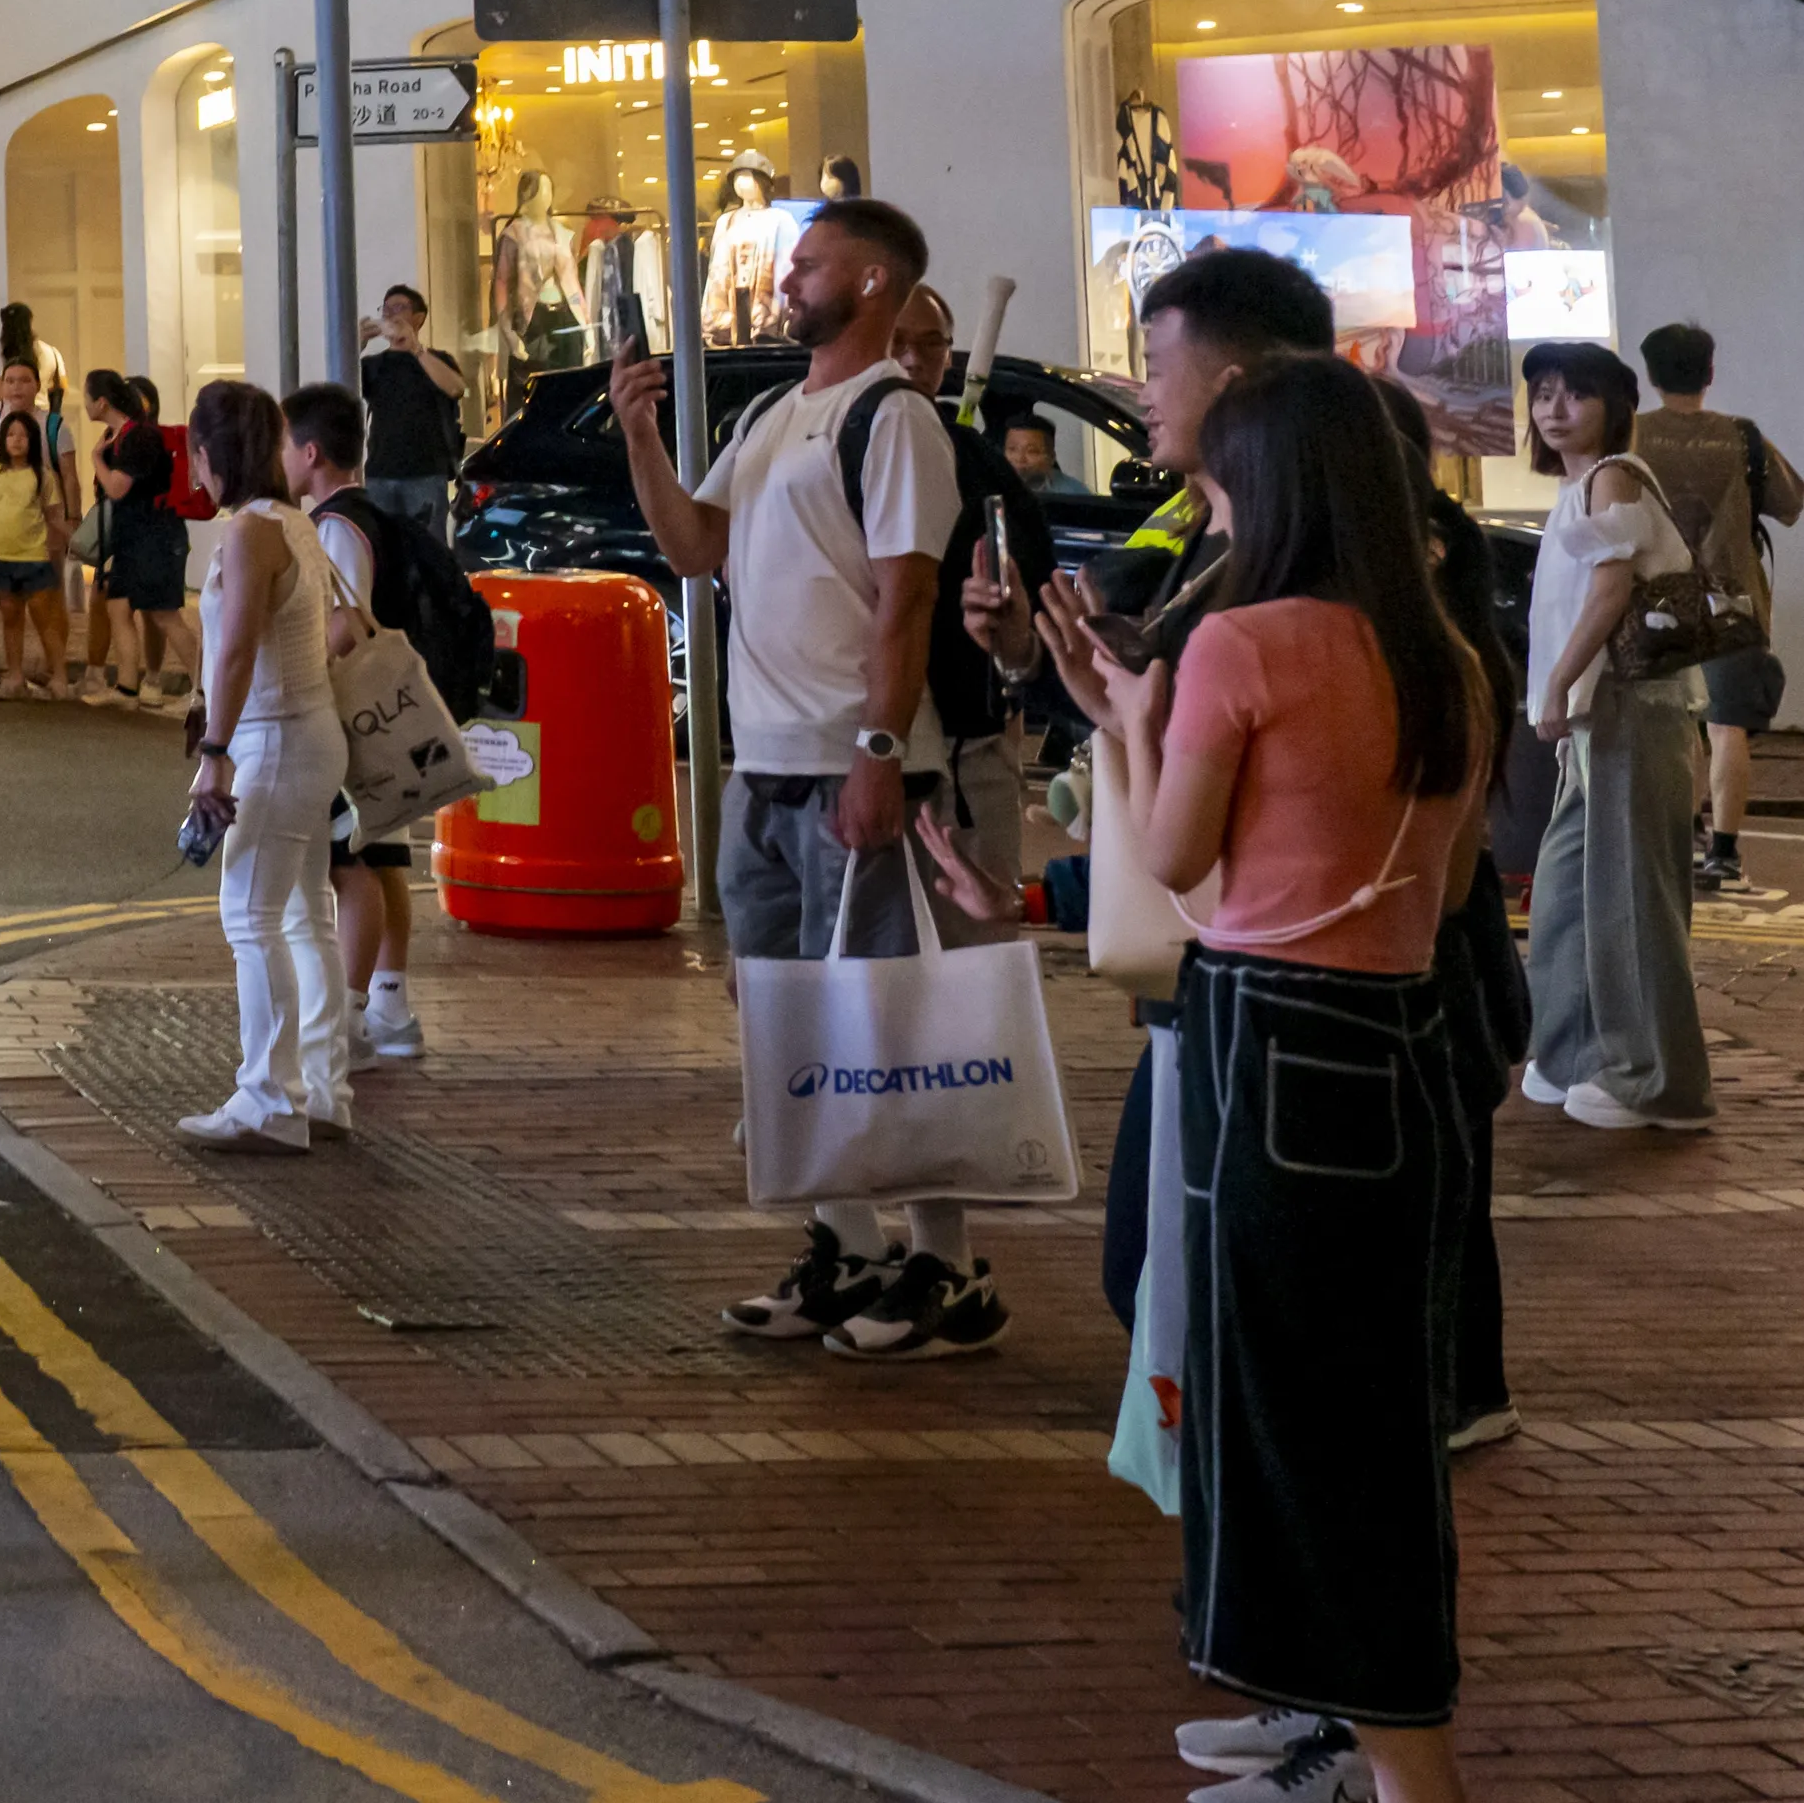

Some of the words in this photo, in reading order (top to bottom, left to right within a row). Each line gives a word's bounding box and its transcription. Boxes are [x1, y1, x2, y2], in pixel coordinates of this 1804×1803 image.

[564, 39, 720, 85] INITIL
[378, 77, 421, 94] Road
[351, 103, 397, 127] 沙道
[412, 107, 445, 121] 20-2
[834, 1056, 1015, 1096] DECATHLON
